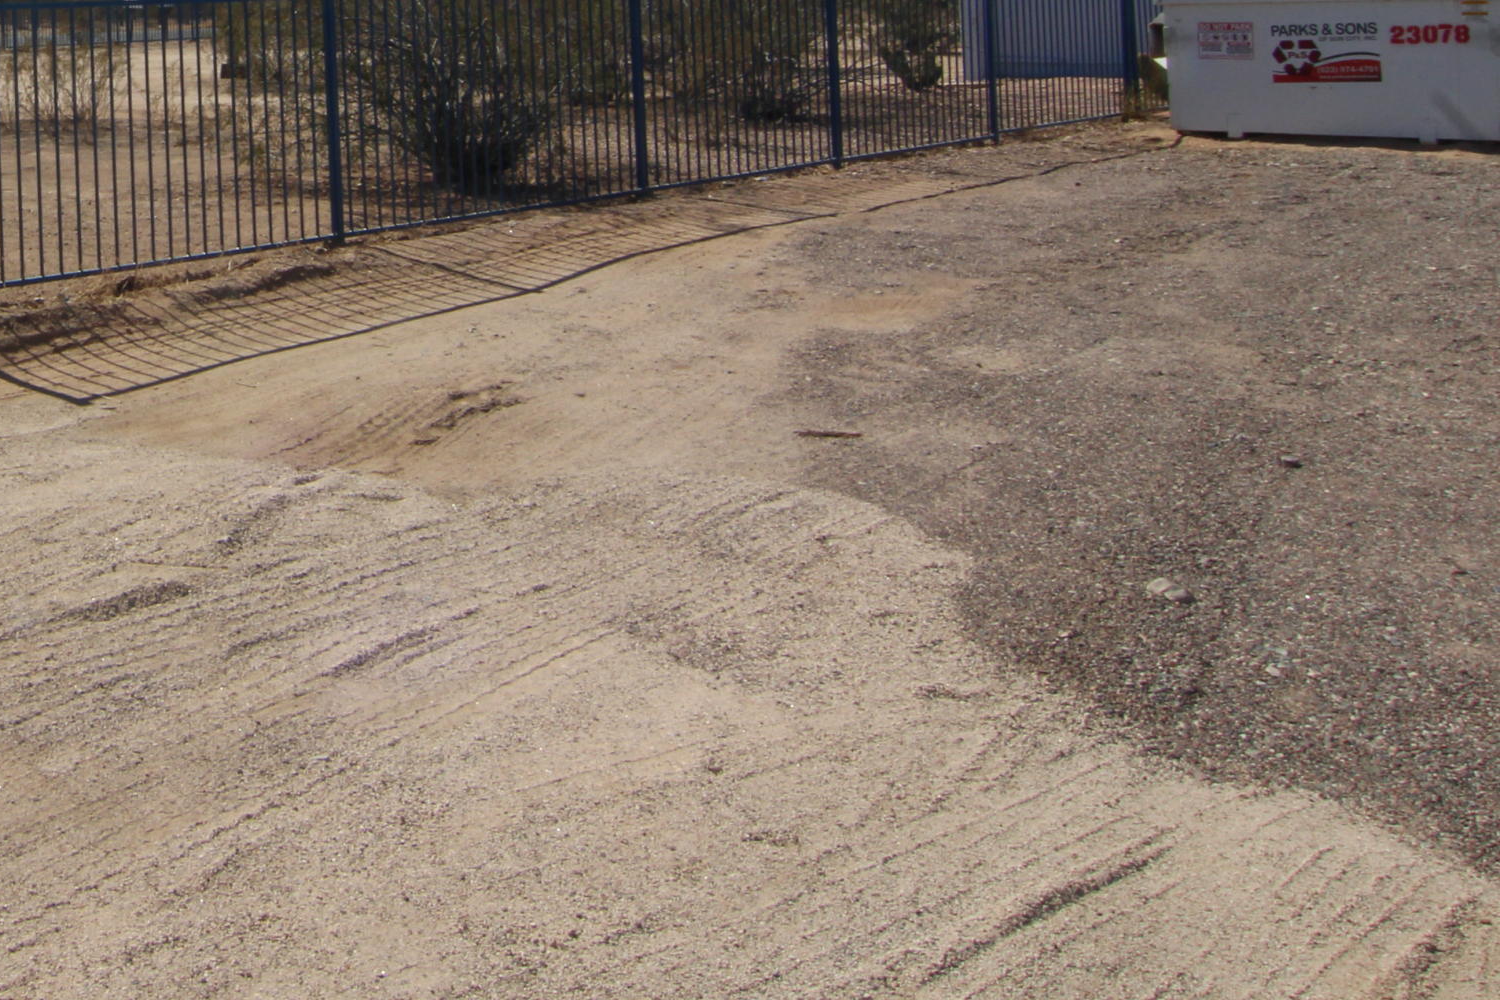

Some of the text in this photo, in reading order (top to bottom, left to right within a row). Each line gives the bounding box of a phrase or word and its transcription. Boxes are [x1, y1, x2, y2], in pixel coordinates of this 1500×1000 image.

[1271, 22, 1377, 36] PARKS & SONS
[1390, 24, 1470, 44] 23078
